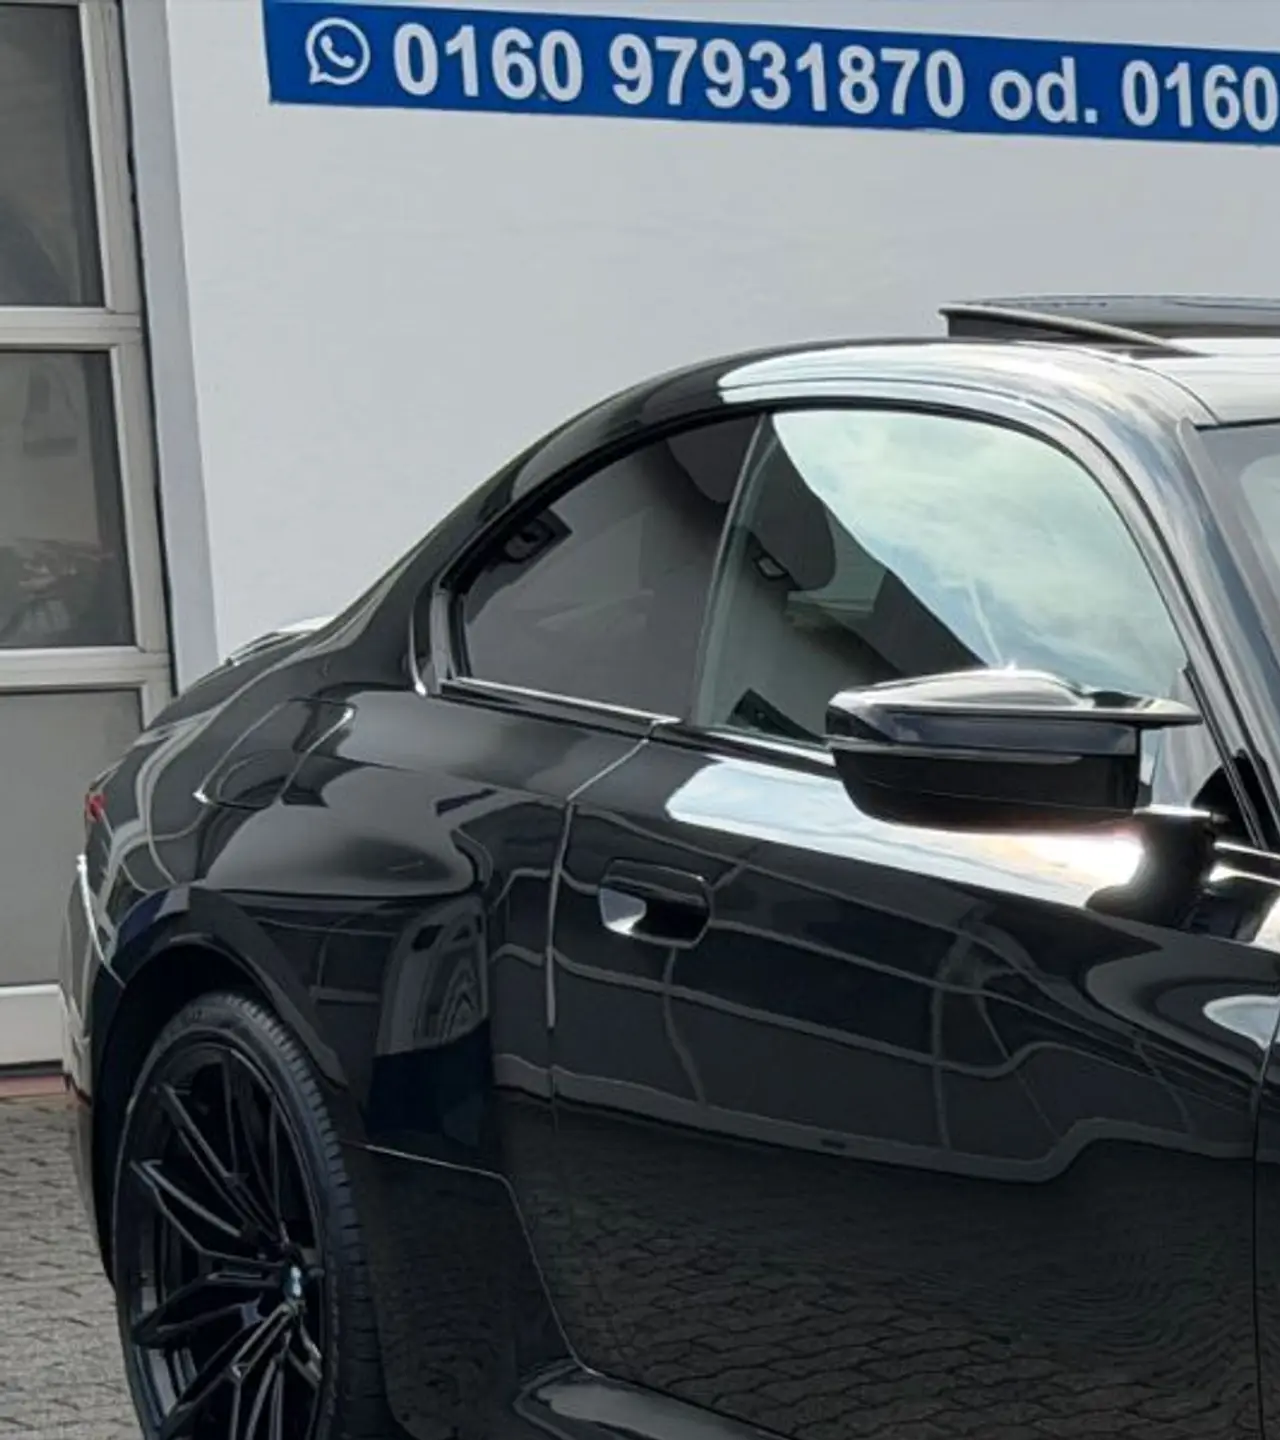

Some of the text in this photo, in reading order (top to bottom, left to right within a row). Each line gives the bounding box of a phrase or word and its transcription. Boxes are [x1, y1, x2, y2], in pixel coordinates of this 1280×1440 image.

[394, 23, 582, 101] 0160
[609, 34, 964, 118] 97931870
[990, 57, 1096, 123] od.
[1122, 60, 1278, 131] 0160
